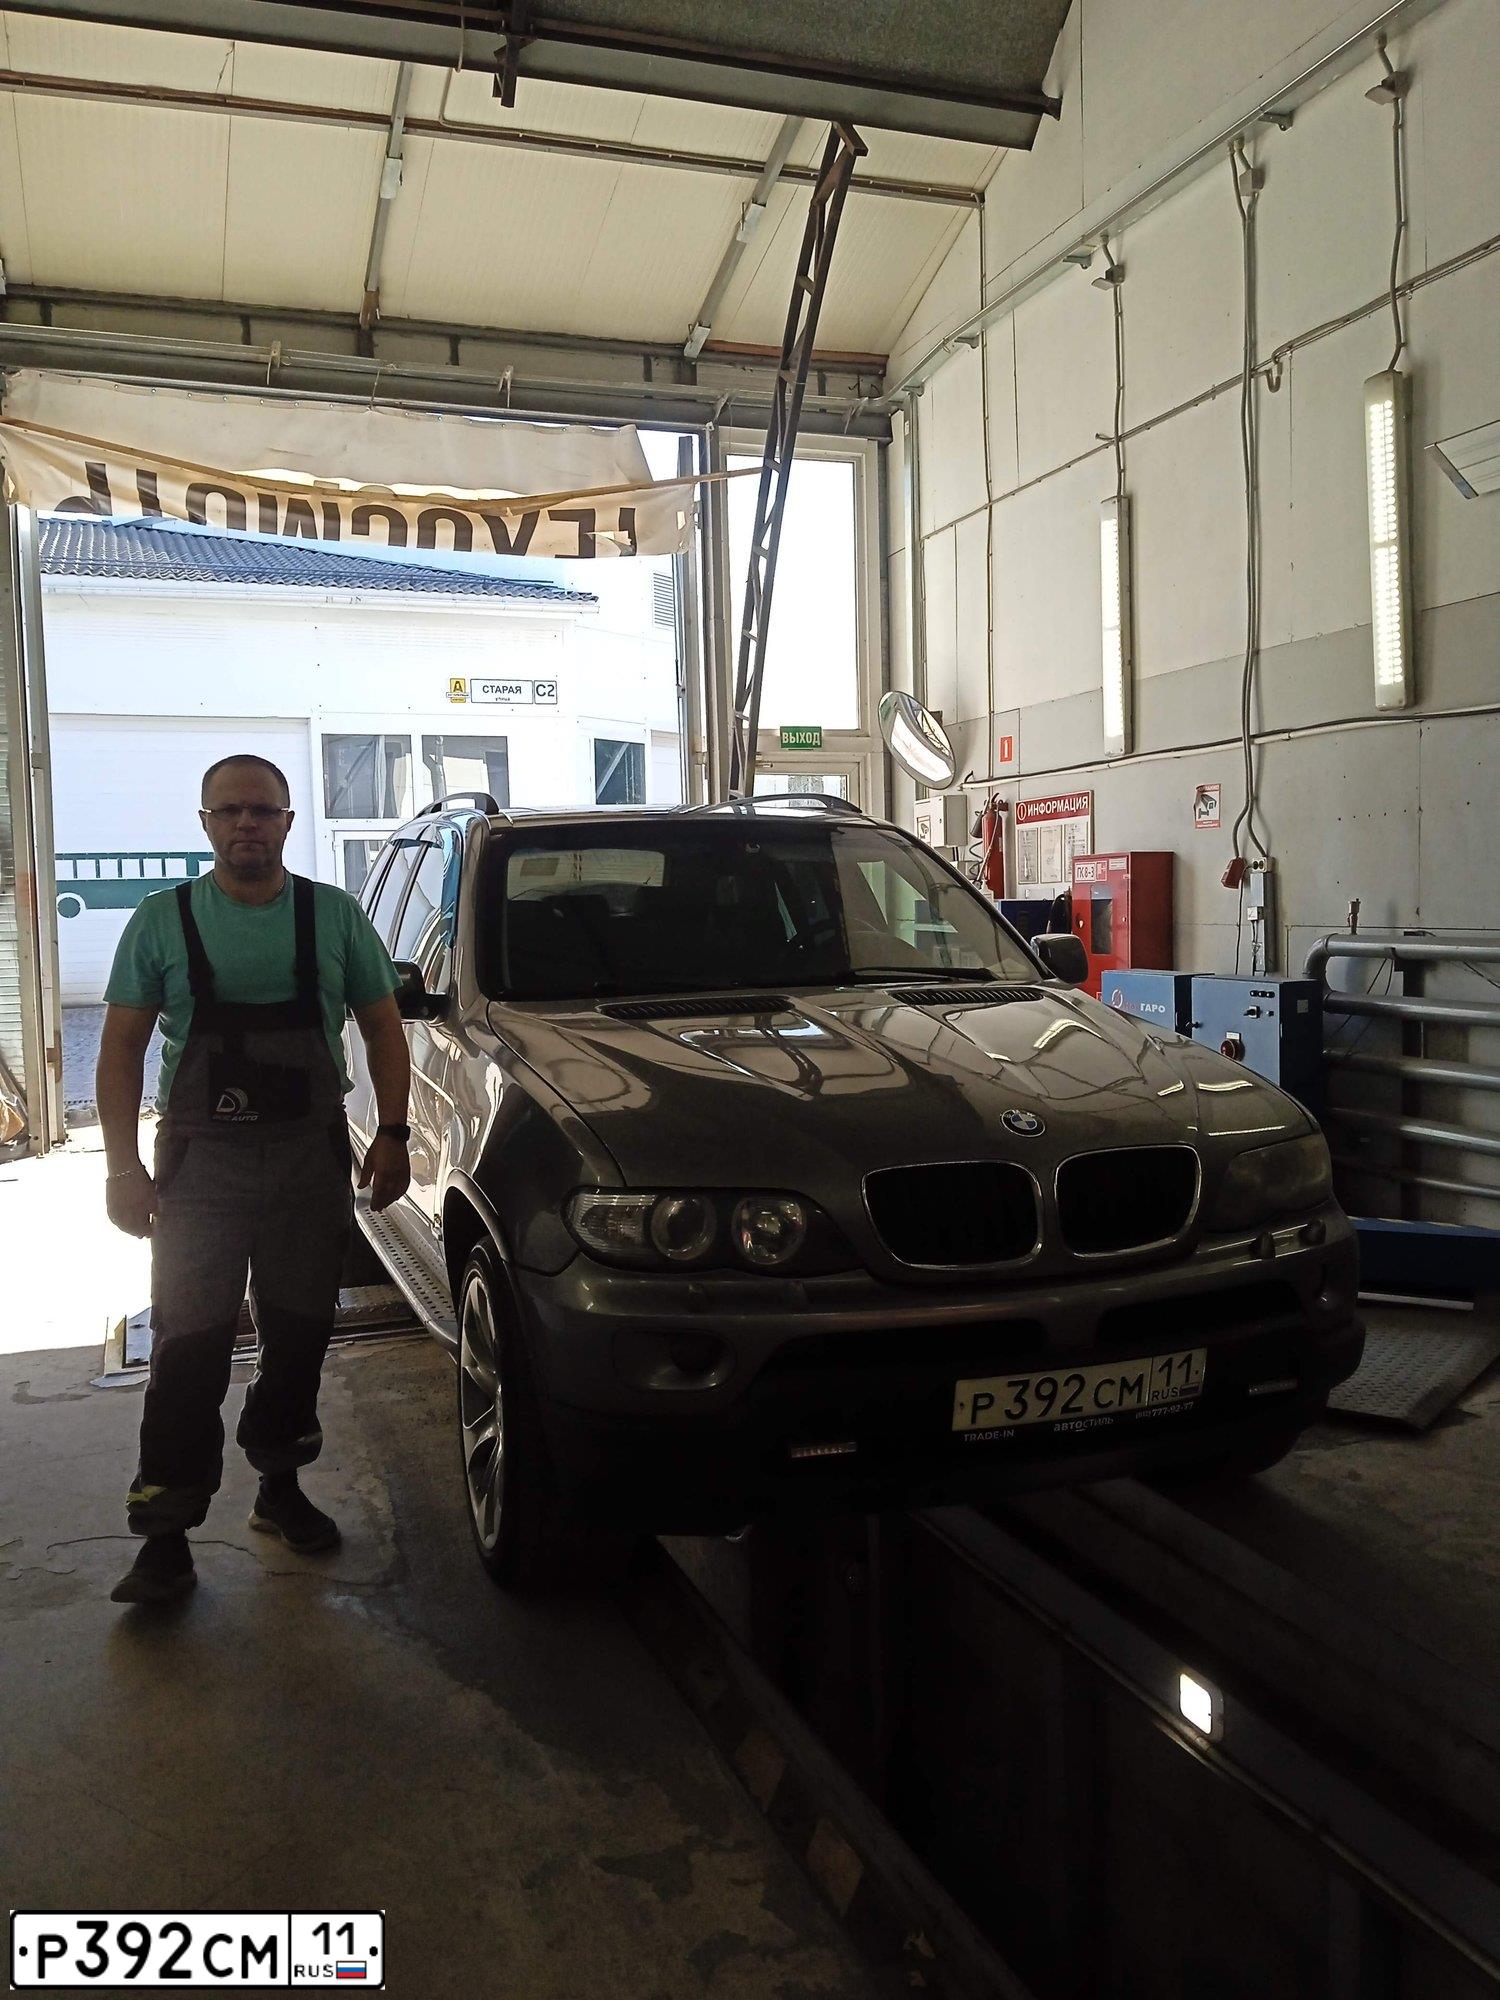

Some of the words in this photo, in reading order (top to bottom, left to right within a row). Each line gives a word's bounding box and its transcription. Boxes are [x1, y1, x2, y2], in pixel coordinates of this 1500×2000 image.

[482, 684, 522, 694] СТАРАЯ
[535, 684, 555, 697] С2
[782, 732, 821, 746] ВЫХОД
[1027, 796, 1088, 817] ИНФОРМАЦИЯ
[1158, 1353, 1193, 1387] 11
[1151, 1384, 1180, 1401] RUS
[963, 1429, 1015, 1442] TRADE-IN
